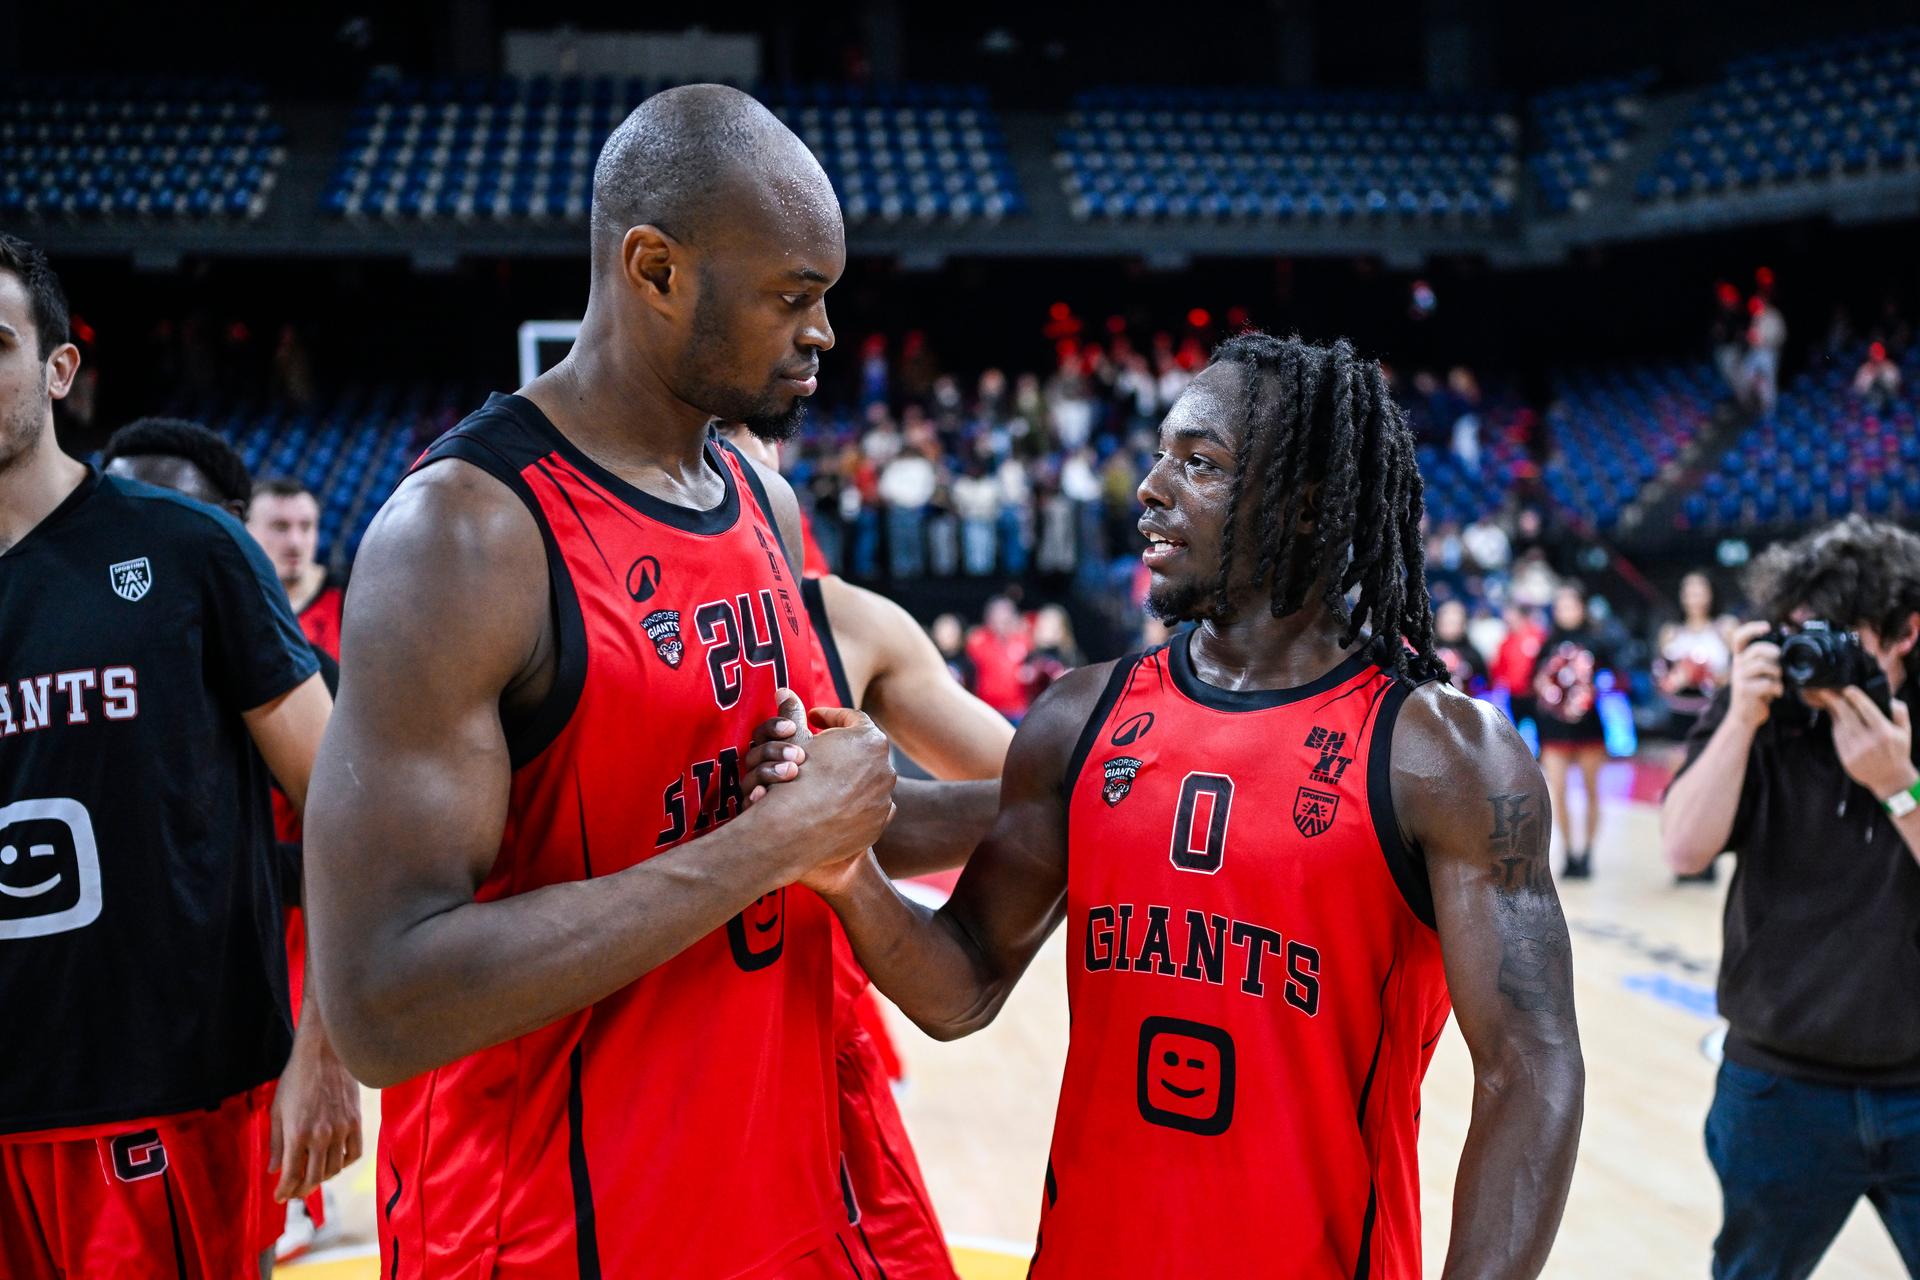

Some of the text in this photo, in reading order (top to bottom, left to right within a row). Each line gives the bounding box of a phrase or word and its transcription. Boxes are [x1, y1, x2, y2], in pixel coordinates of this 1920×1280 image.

[640, 611, 679, 629] WINDROSE
[647, 621, 680, 639] GIANTS
[694, 589, 789, 711] 24
[0, 665, 138, 737] ANTS
[1104, 759, 1142, 769] WINDROSE
[1104, 767, 1136, 778] GIANTS
[1308, 773, 1339, 786] LEAGUE
[1301, 791, 1335, 805] SPORTING
[1169, 770, 1235, 875] 0
[1084, 904, 1320, 1018] GIANTS
[110, 1128, 168, 1183] G
